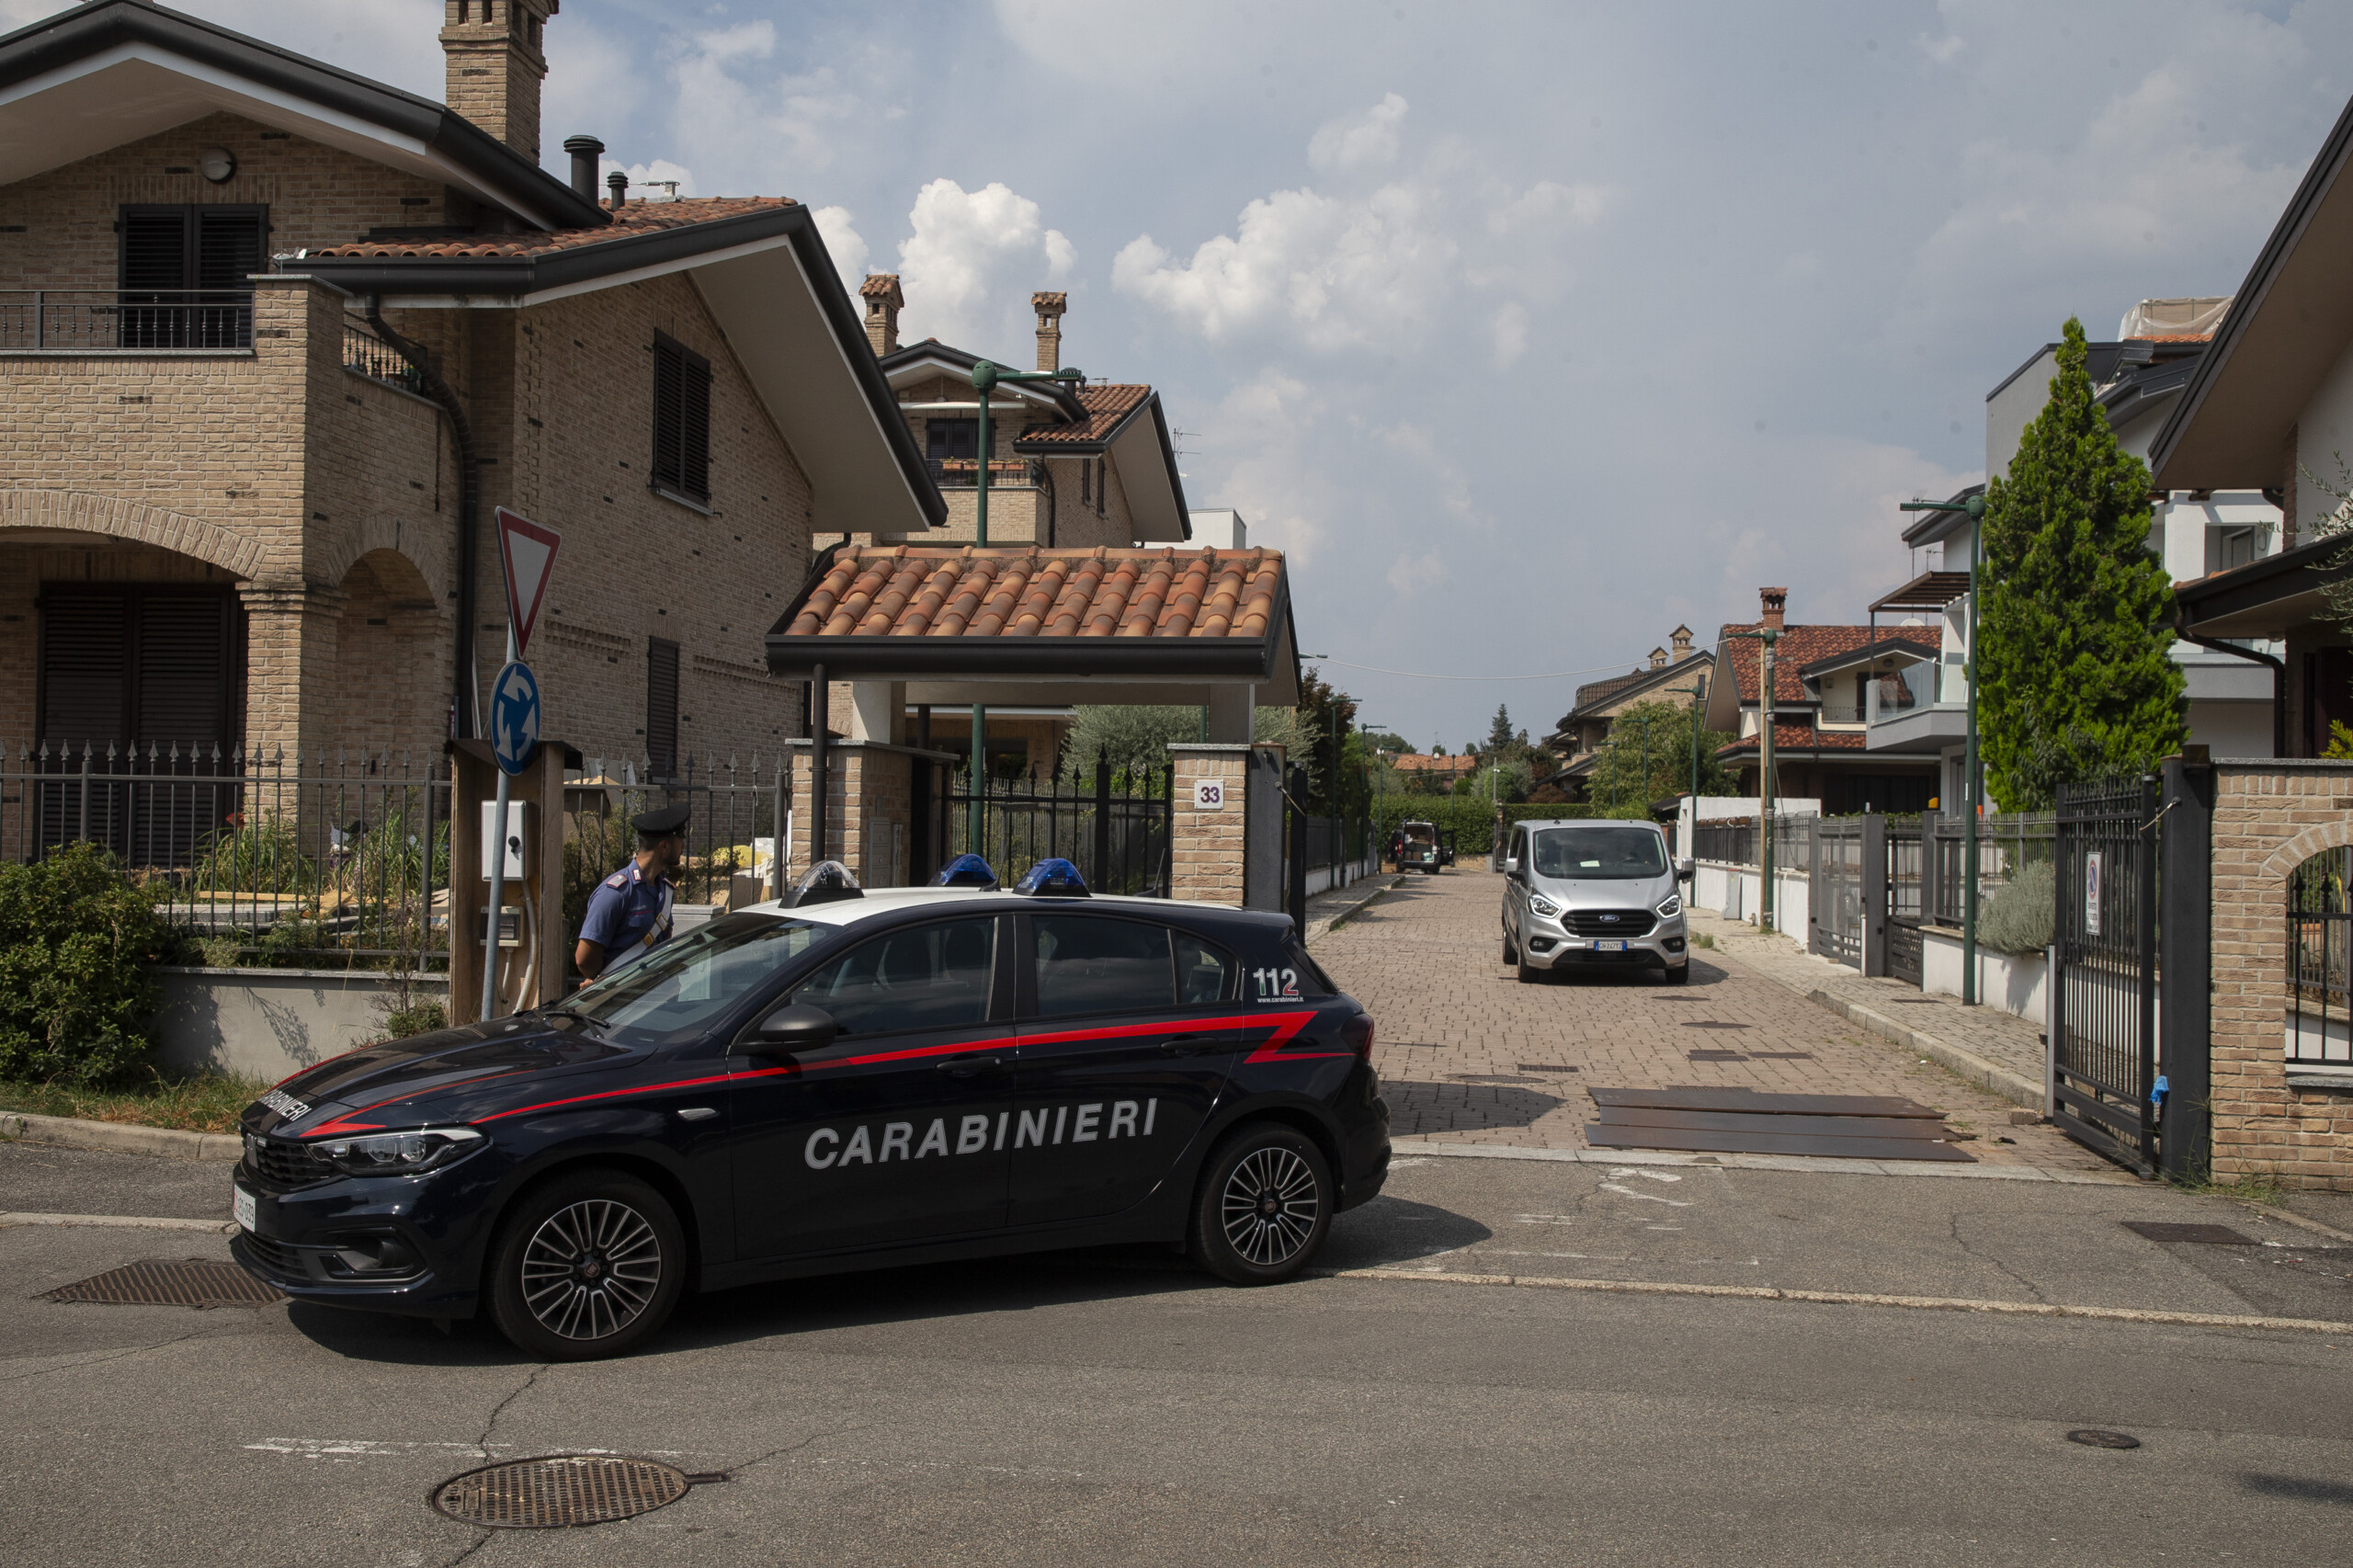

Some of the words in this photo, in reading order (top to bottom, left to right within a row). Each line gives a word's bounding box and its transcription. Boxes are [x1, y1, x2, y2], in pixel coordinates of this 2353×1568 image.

[1200, 787, 1220, 803] 33
[1253, 968, 1299, 995] 112
[258, 1089, 313, 1121] ARABINIERI
[804, 1097, 1157, 1169] CARABINIERI
